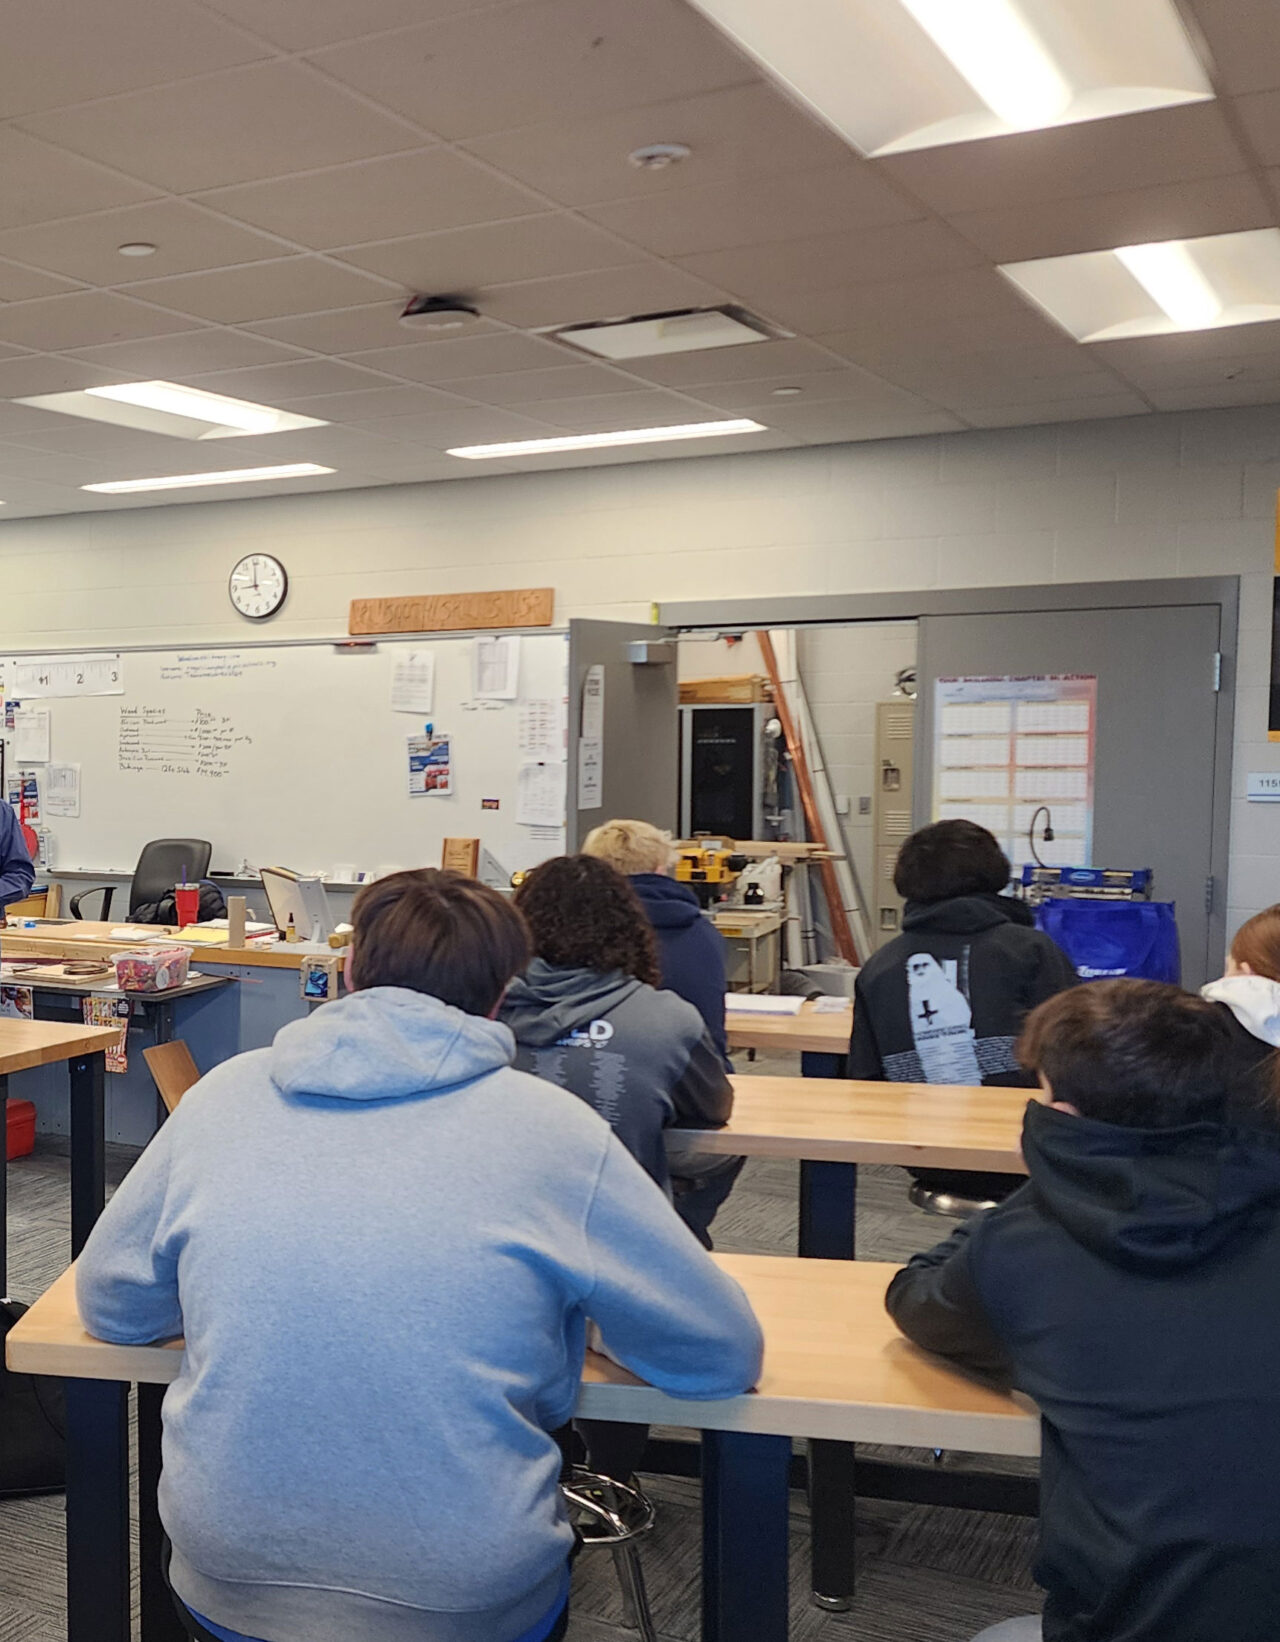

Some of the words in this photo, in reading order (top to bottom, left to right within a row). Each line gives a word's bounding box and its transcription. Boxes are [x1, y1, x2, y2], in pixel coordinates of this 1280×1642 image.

[77, 674, 85, 685] 2
[111, 672, 118, 682] 3
[1259, 779, 1280, 788] 115
